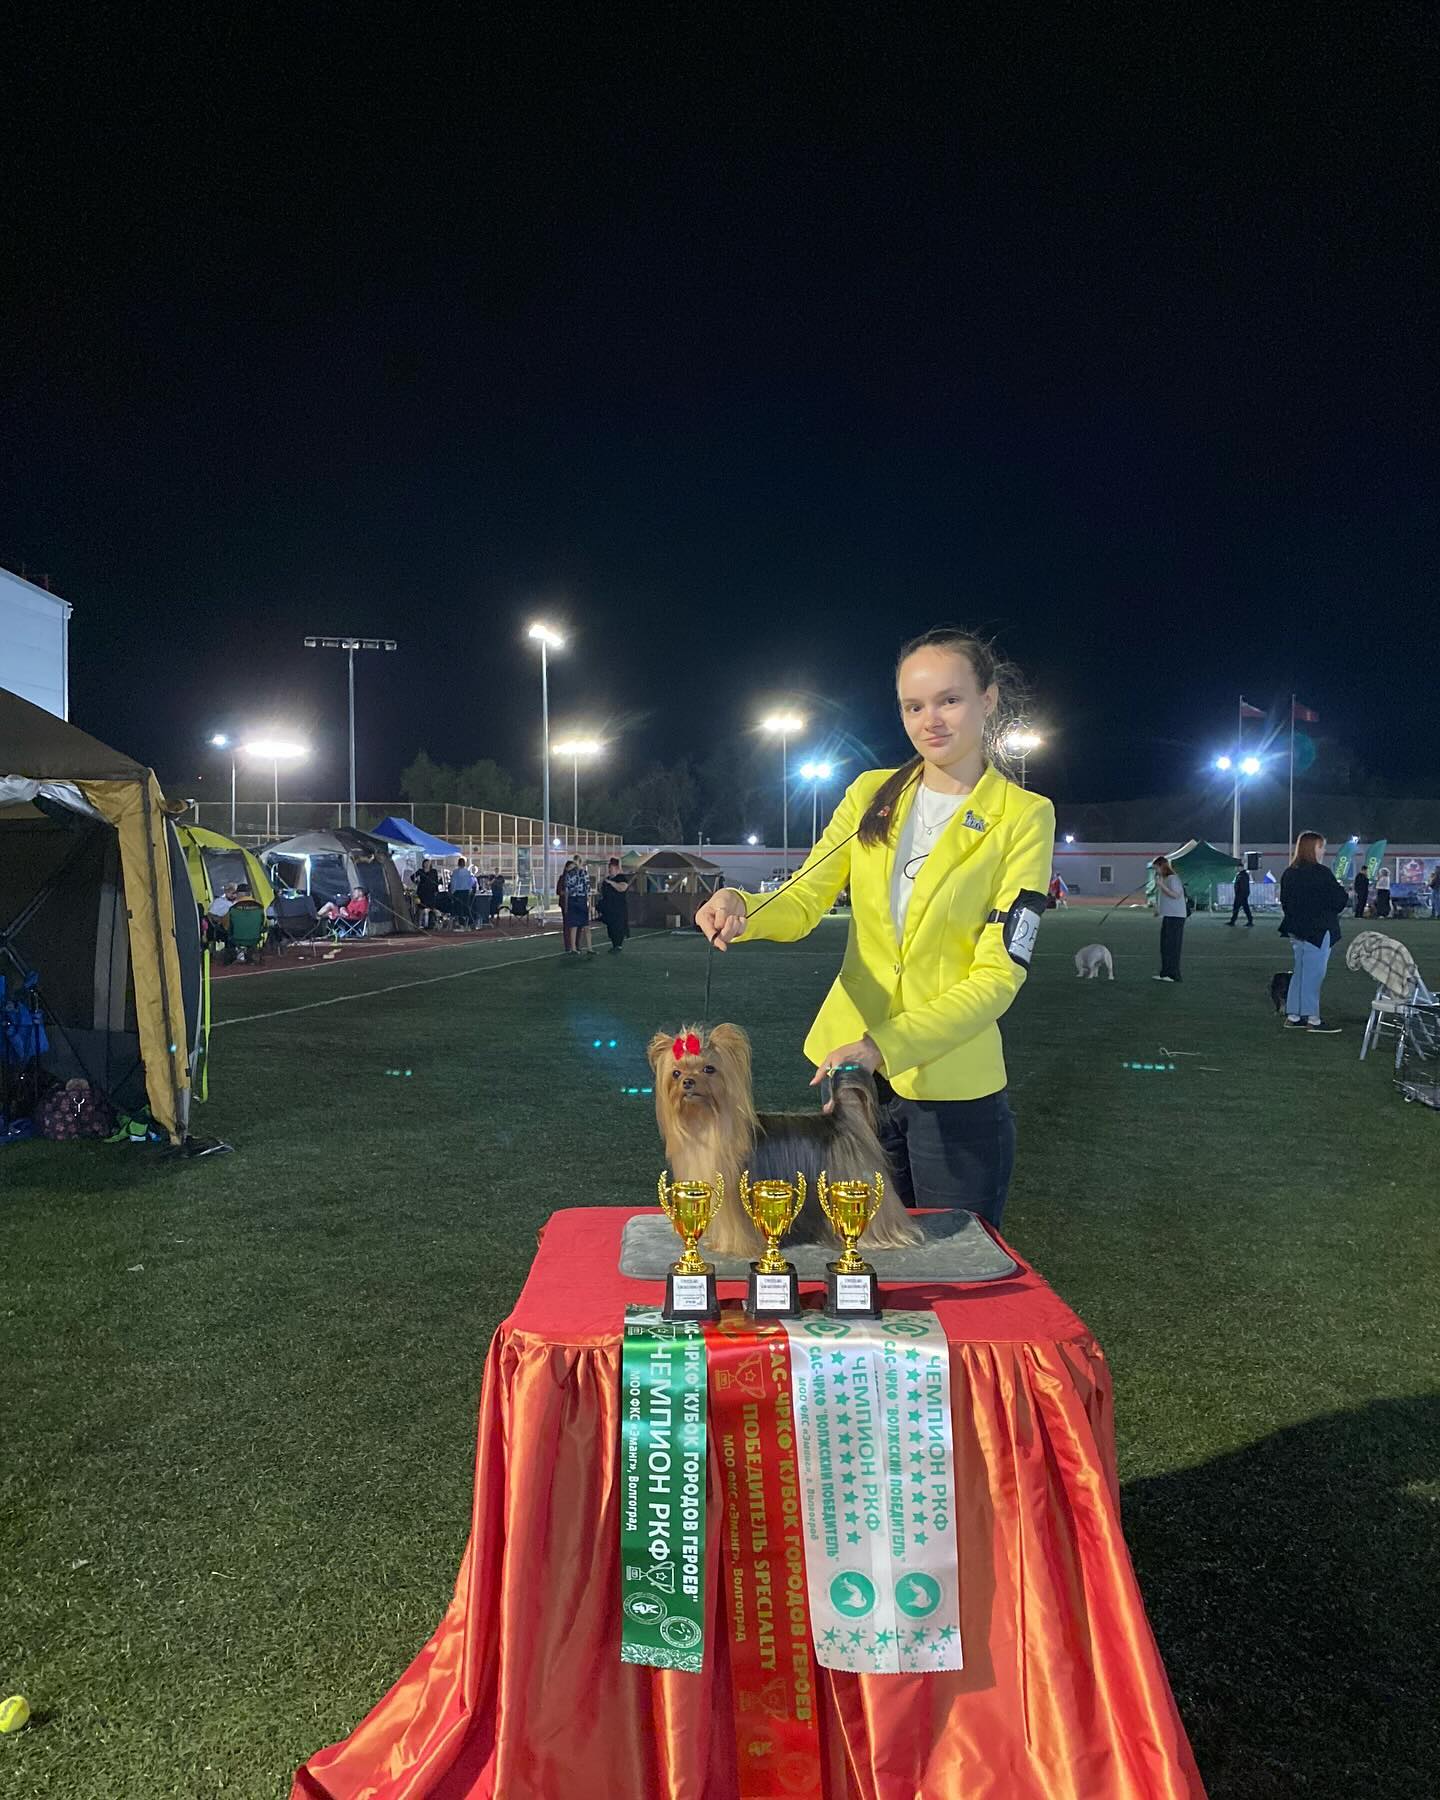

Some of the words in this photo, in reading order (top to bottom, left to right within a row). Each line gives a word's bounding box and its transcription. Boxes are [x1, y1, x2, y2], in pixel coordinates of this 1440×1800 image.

[629, 1370, 640, 1396] МОО
[629, 1398, 641, 1420] ФКС
[798, 1377, 808, 1401] МОО
[799, 1405, 810, 1426] ФКС
[852, 1357, 876, 1475] ЧЕМПИОН
[926, 1356, 946, 1475] ЧЕМПИОН
[648, 1344, 672, 1493] ЧЕМПИОН
[723, 1435, 736, 1467] МОО
[626, 1475, 640, 1531] Волгоград
[680, 1452, 699, 1531] ГОРОДОВ
[727, 1471, 738, 1499] ФКС
[742, 1403, 768, 1552] ПОБЕДИТЕЛЬ
[862, 1485, 880, 1531] РКФ
[931, 1485, 948, 1531] РКФ
[648, 1503, 671, 1561] РКФ
[822, 1483, 839, 1562] ПОБЕДИТЕЛЬ"
[889, 1479, 906, 1562] ПОБЕДИТЕЛЬ"
[682, 1536, 699, 1602] ГЕРОЕВ"
[784, 1535, 806, 1636] ГОРОДОВ
[732, 1568, 746, 1641] Волгоград
[754, 1560, 777, 1671] SPECIALTY
[792, 1643, 812, 1730] ГЕРОЕВ"
